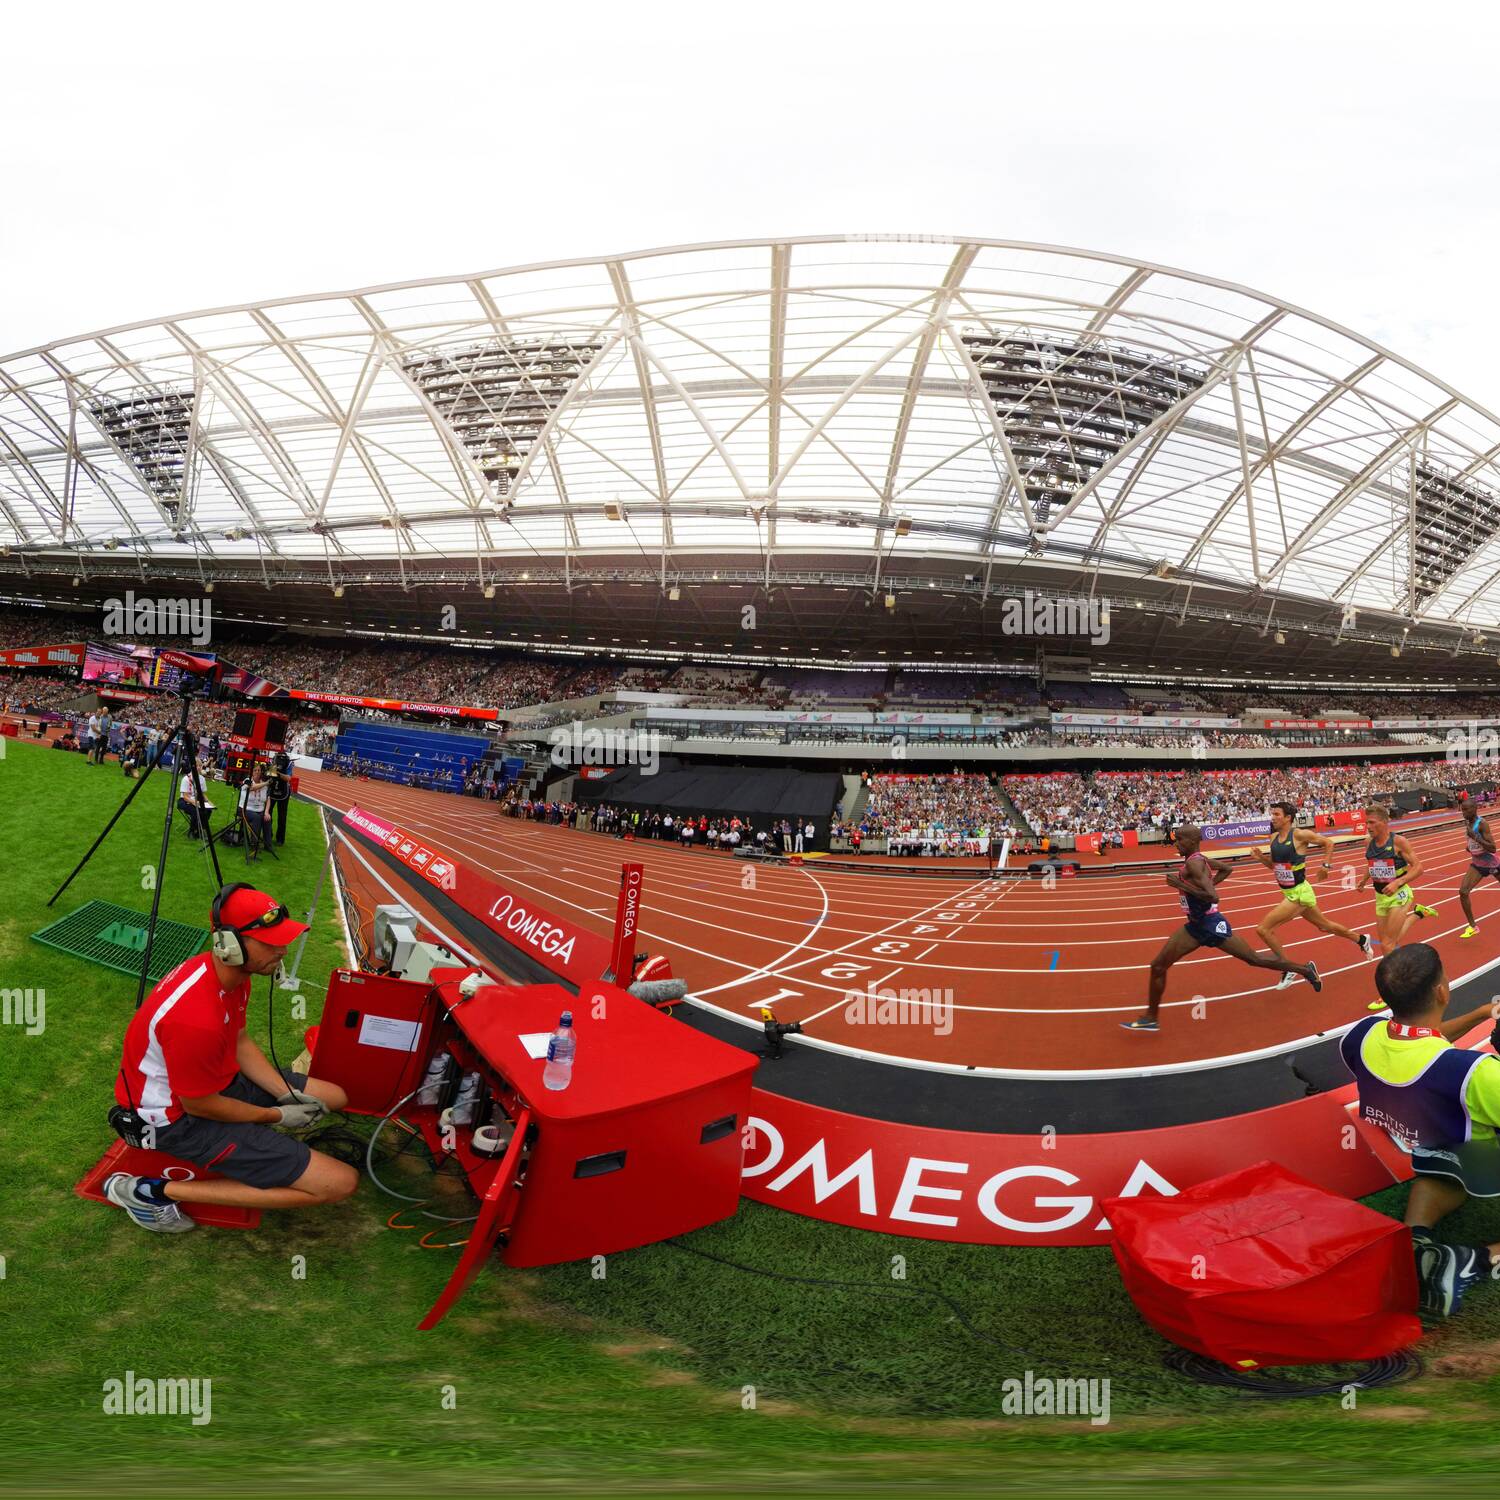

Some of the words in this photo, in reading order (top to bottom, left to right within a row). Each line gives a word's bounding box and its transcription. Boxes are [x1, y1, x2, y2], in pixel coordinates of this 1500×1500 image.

[48, 649, 80, 663] müller
[623, 888, 638, 938] OMEGA
[507, 908, 576, 965] OMEGA
[912, 924, 939, 934] 4
[872, 941, 910, 954] 3
[821, 962, 872, 978] 2
[748, 988, 804, 1009] 1
[1364, 1116, 1420, 1147] ATHLETICS
[1365, 1106, 1418, 1138] BRITISH
